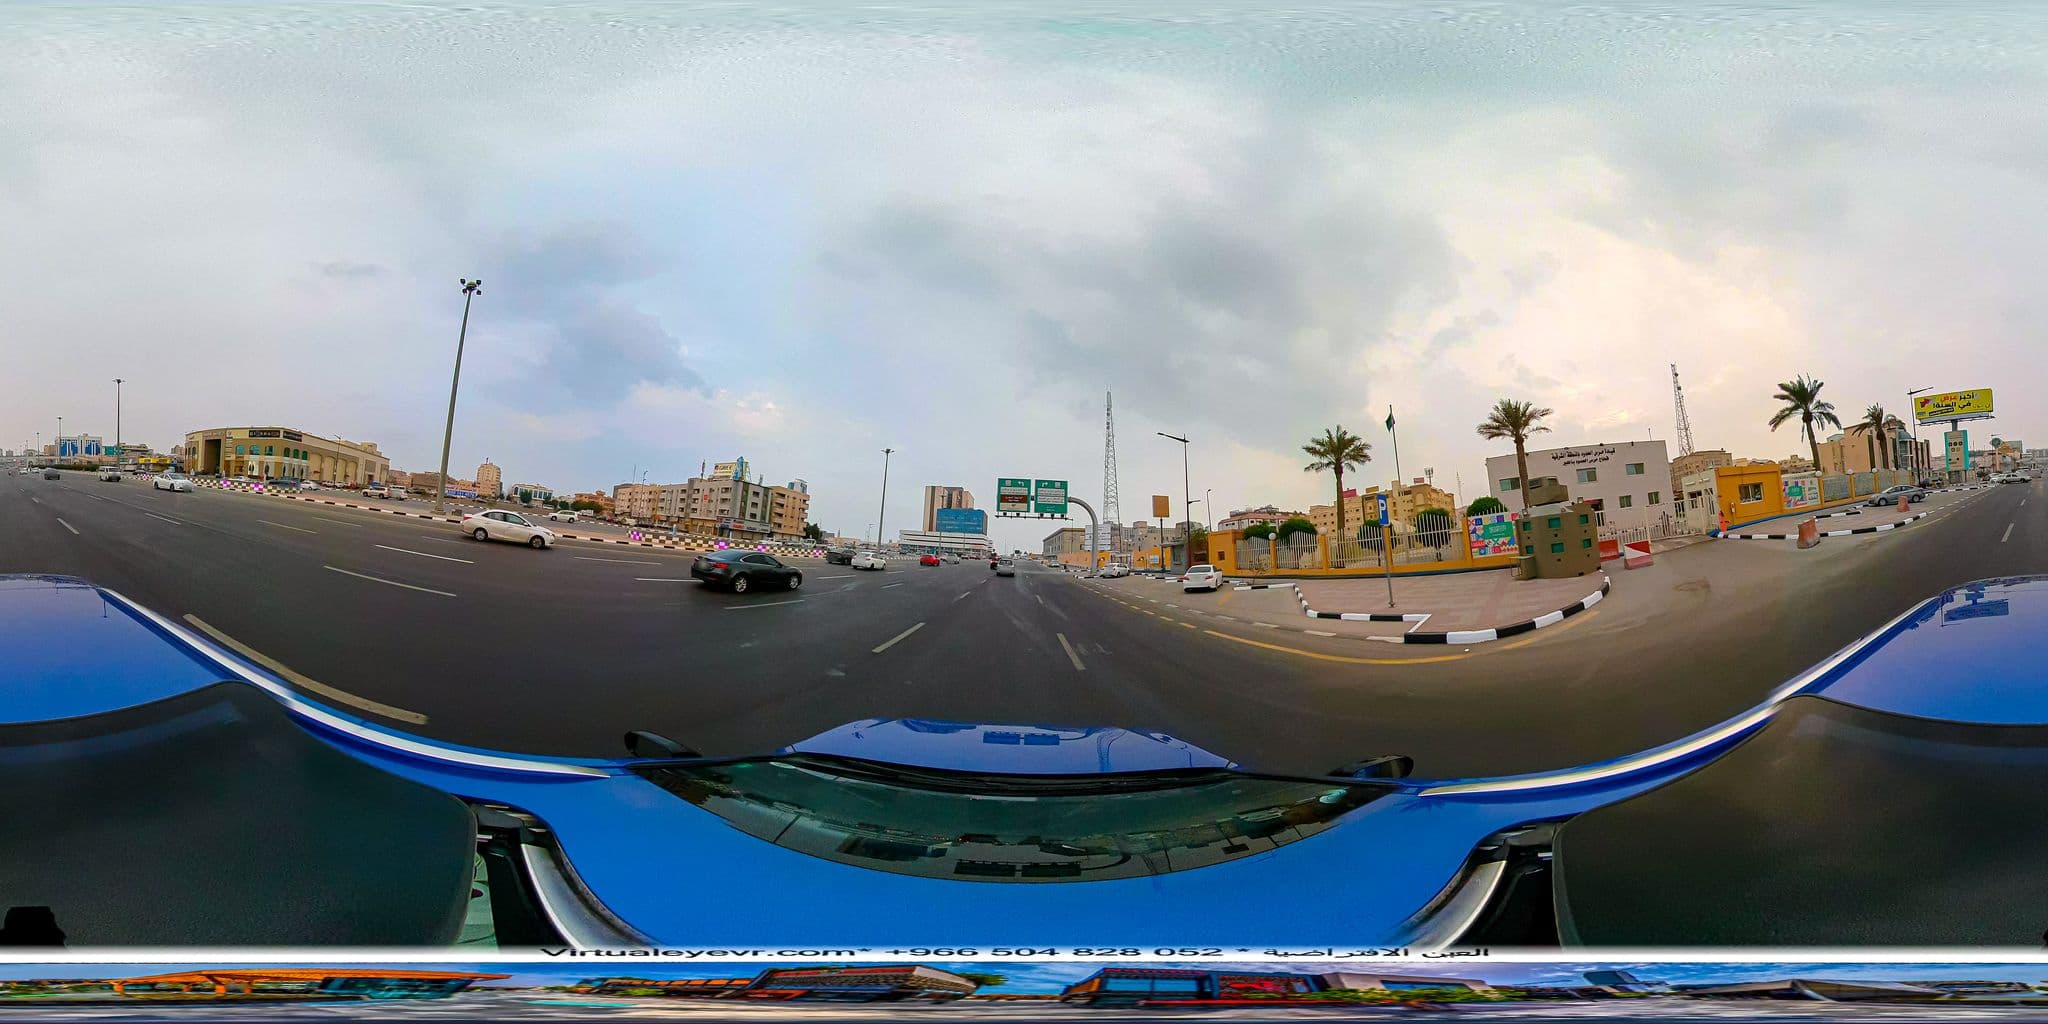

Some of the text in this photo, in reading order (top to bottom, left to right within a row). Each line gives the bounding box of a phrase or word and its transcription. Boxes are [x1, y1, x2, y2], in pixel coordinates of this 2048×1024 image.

[1959, 392, 1974, 401] أكبر
[1958, 401, 1972, 409] في
[1378, 499, 1386, 519] P
